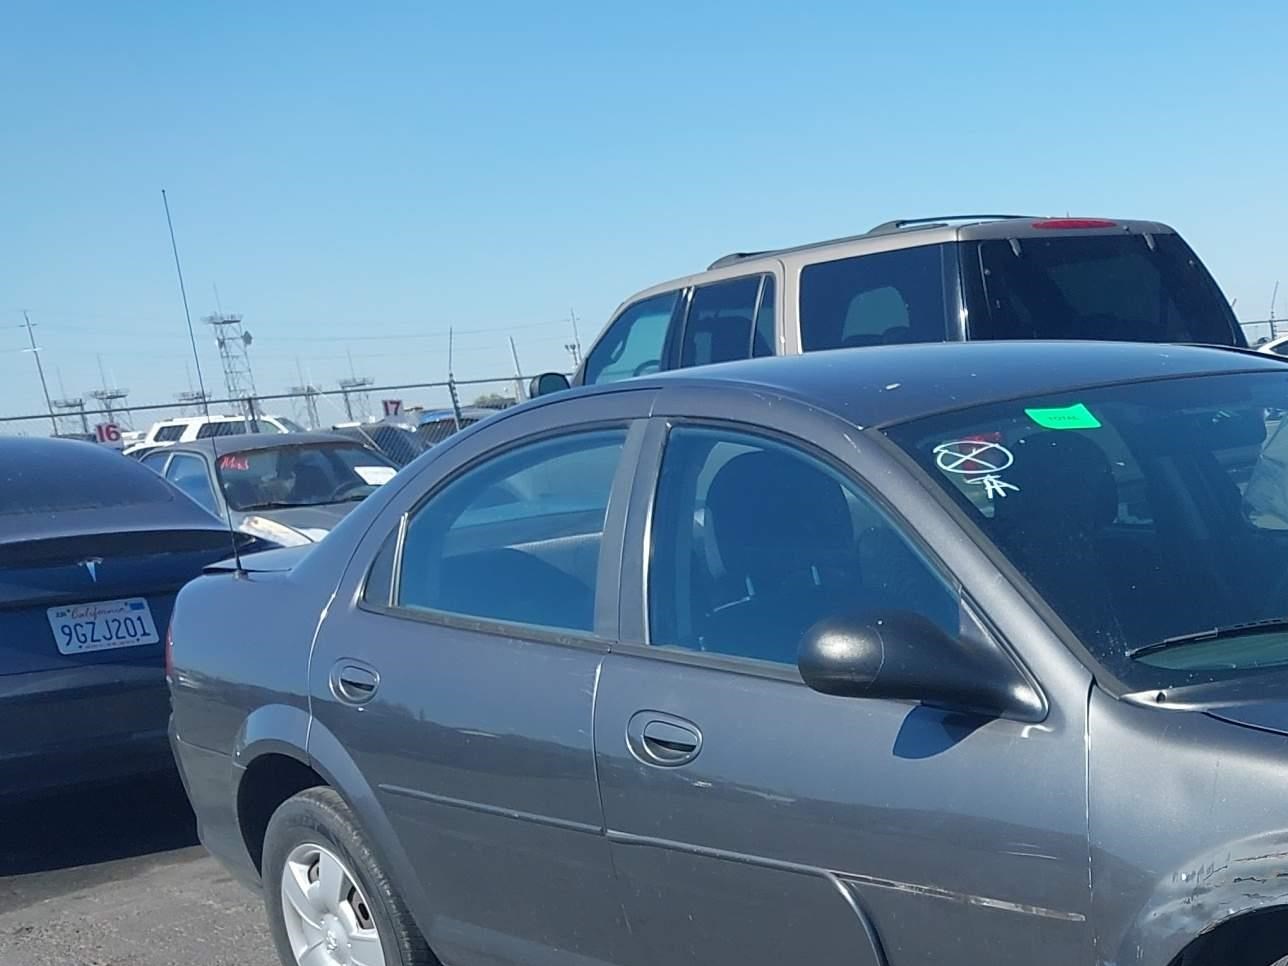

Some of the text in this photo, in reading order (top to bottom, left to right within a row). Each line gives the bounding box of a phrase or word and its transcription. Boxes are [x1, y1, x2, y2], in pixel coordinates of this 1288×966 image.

[383, 400, 402, 417] 17
[96, 424, 121, 443] 16
[60, 615, 152, 647] 9GZJ201
